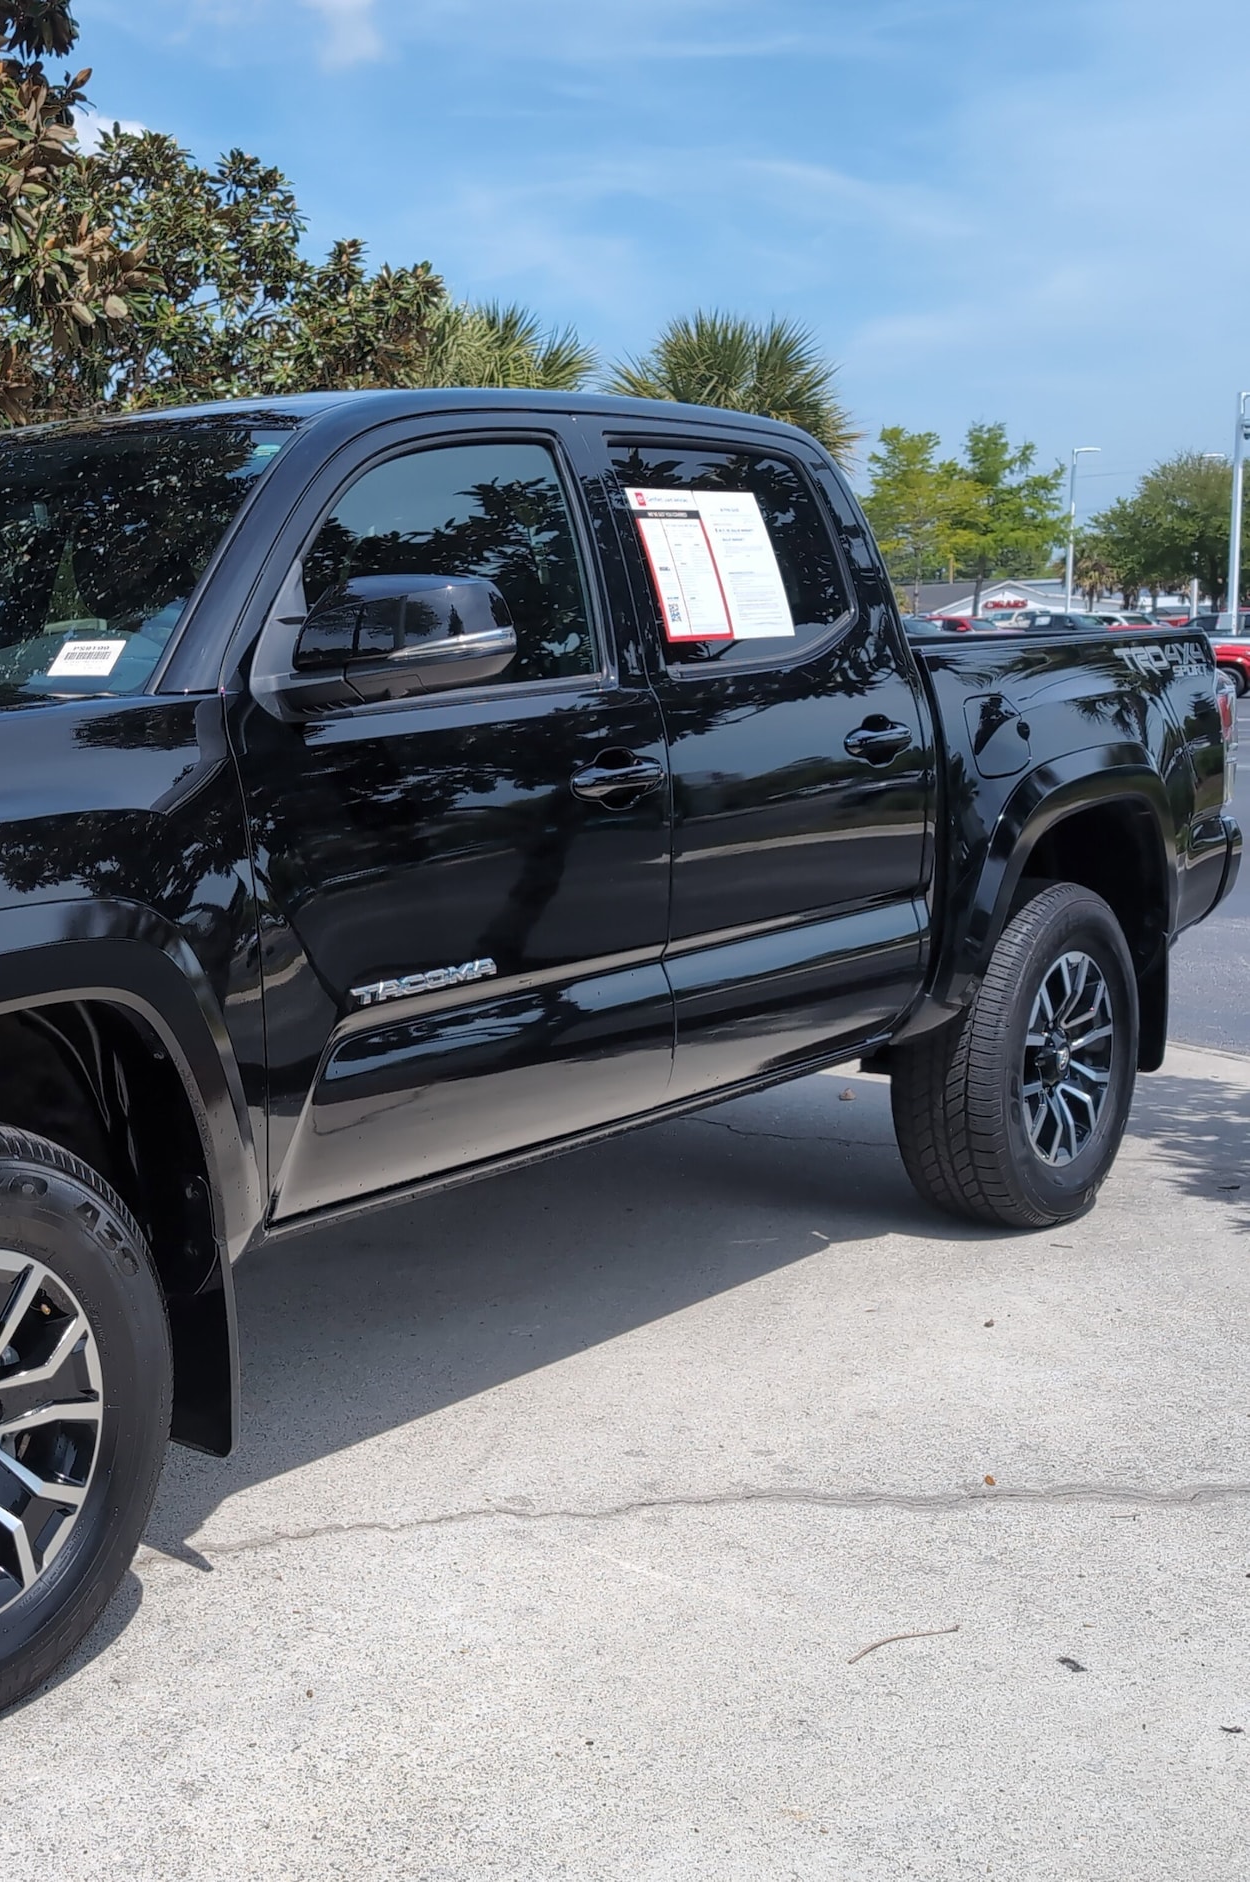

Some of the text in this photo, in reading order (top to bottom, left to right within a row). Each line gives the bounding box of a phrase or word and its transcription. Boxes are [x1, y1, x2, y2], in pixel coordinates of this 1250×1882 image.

[983, 599, 1028, 610] CIGARS
[1113, 645, 1170, 677] TRD
[1172, 663, 1210, 677] SPORT
[350, 957, 498, 1005] TACOMA
[72, 1200, 142, 1278] A30
